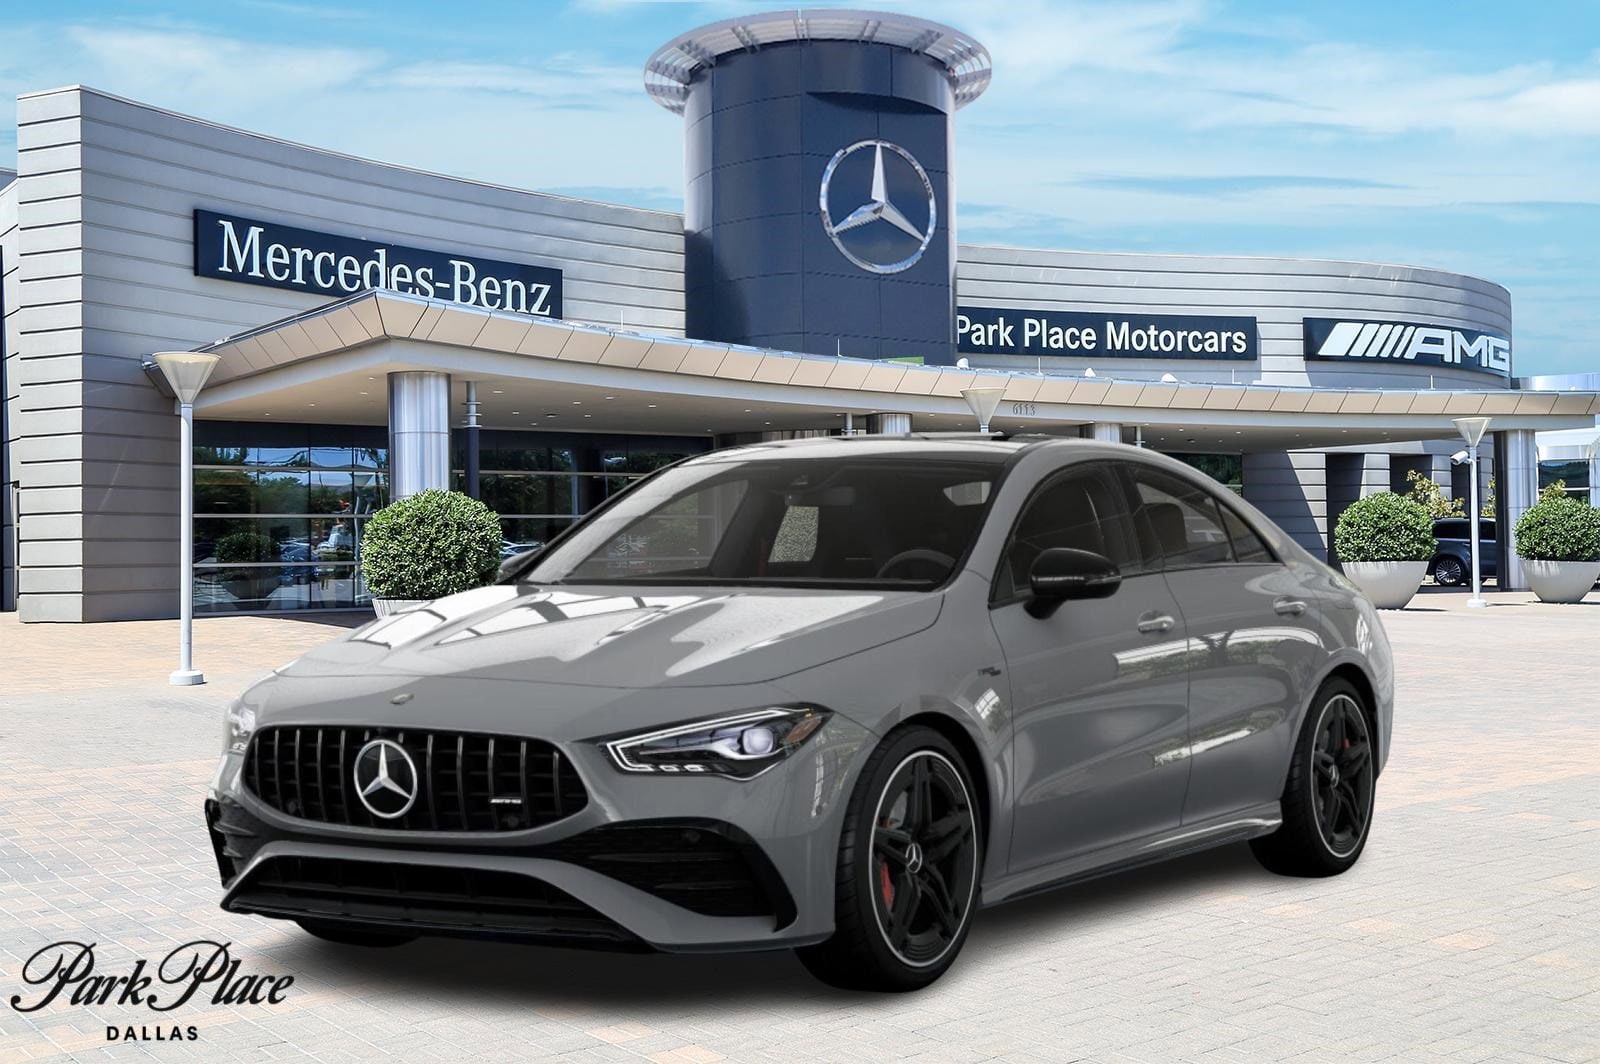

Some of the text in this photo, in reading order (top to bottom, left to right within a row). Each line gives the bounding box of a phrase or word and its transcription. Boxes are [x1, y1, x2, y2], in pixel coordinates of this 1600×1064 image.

[218, 219, 551, 316] Mercedes-Benz
[957, 315, 1247, 353] Park Place Motorcars
[1403, 326, 1510, 372] AMG
[1012, 402, 1036, 416] 6113
